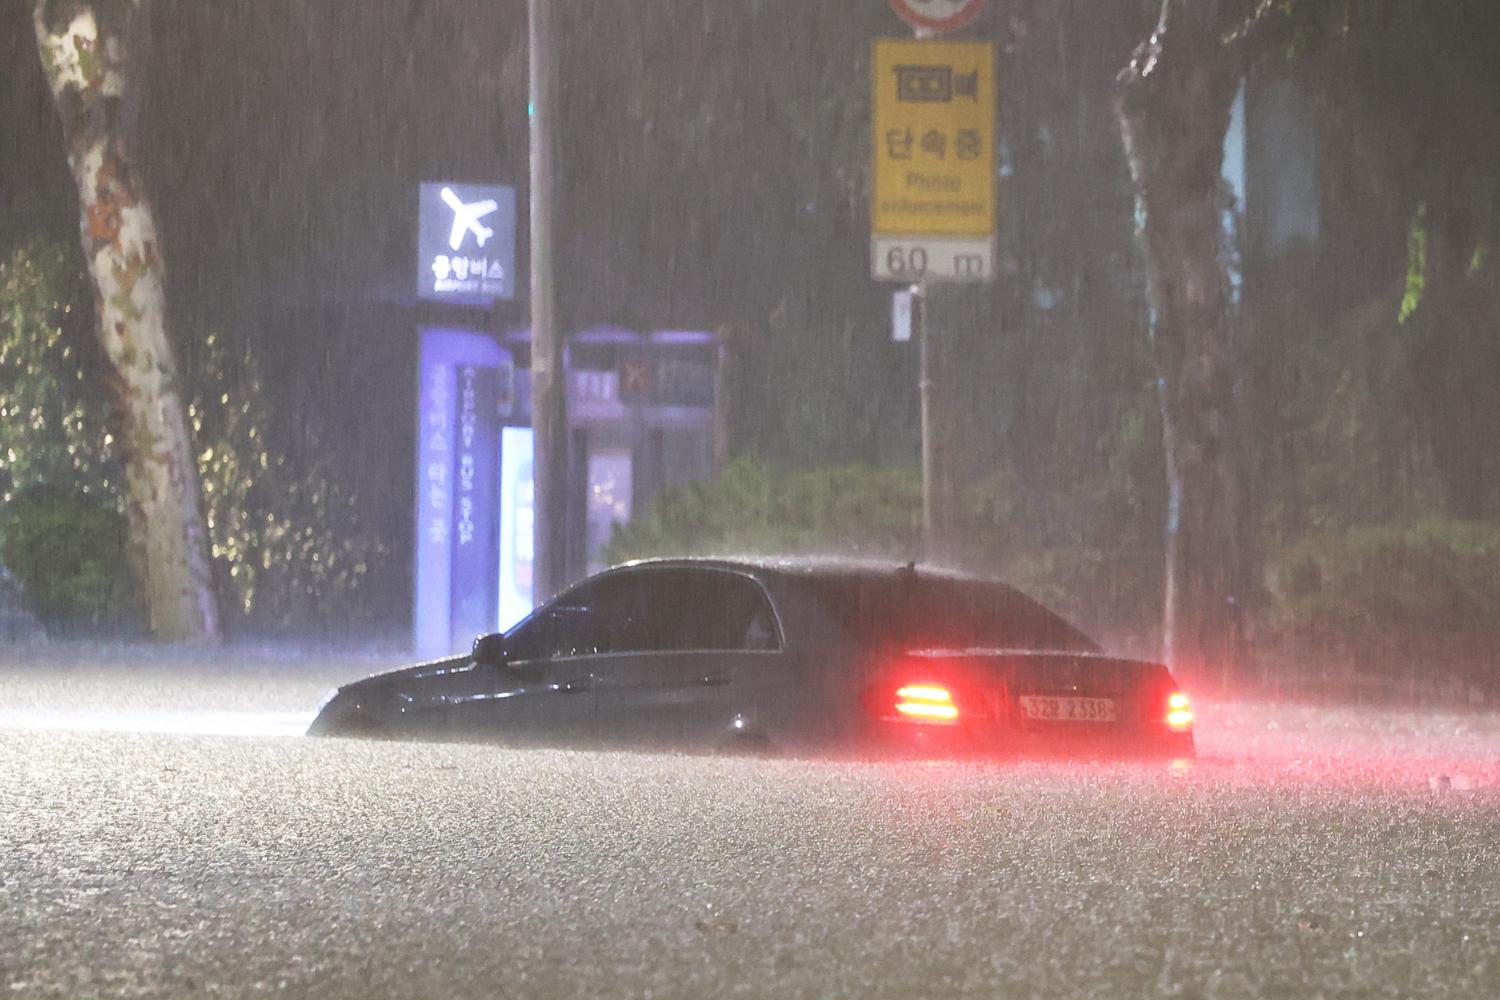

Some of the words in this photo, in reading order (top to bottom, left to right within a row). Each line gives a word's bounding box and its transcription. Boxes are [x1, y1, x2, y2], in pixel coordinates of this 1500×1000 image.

[886, 127, 982, 161] 단속중
[431, 254, 504, 281] 공항버스
[886, 245, 928, 277] 60
[953, 254, 984, 275] m
[460, 453, 475, 491] BUS
